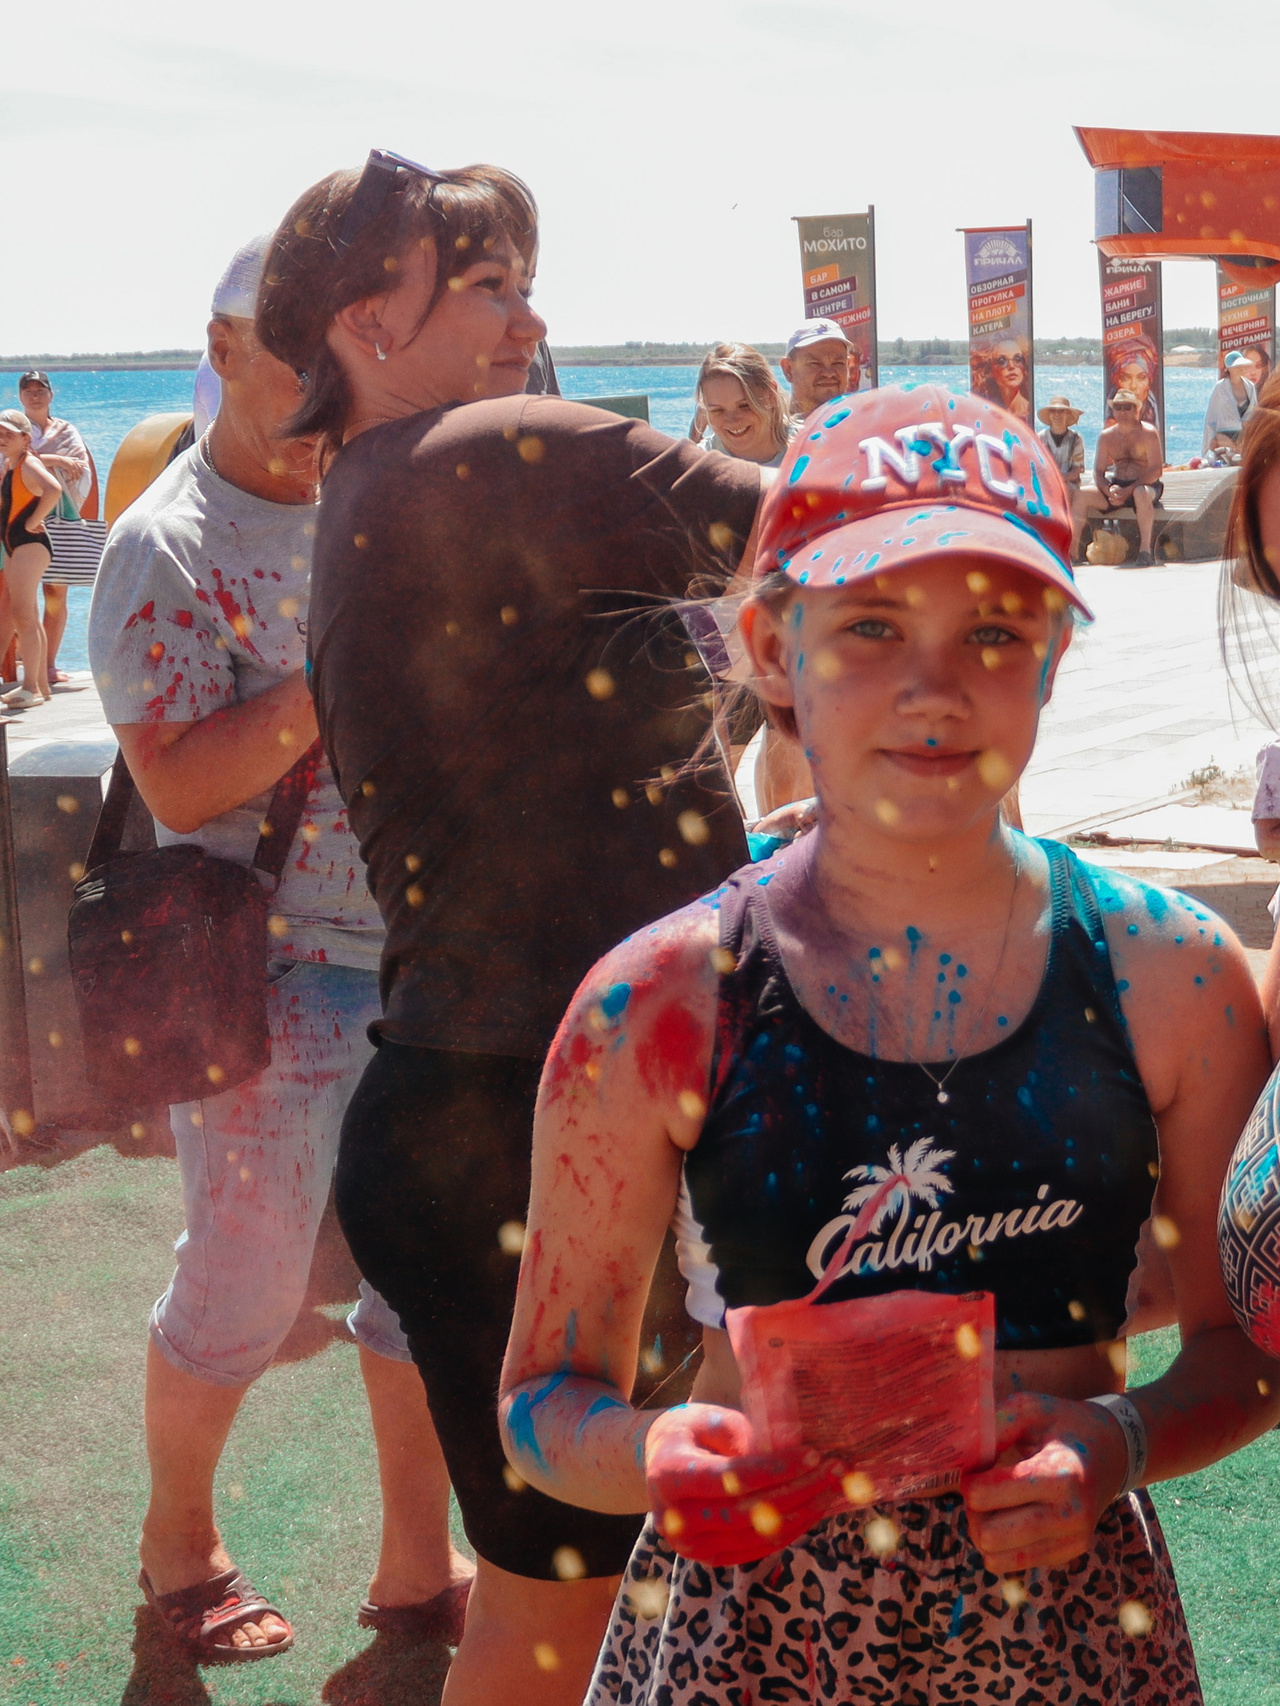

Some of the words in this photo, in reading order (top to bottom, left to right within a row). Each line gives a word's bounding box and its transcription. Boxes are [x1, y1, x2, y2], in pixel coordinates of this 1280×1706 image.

[823, 226, 844, 239] бар
[803, 237, 867, 253] МОХИТО
[973, 256, 1023, 266] ПРИЧАЛ
[1105, 264, 1152, 274] ПРИЧАЛ
[810, 272, 828, 284] БАР
[970, 275, 1014, 294] ОБЗОРНАЯ
[811, 291, 818, 301] В
[819, 282, 851, 299] САМОМ
[1104, 279, 1143, 298] ЖАРКИЕ
[1221, 285, 1238, 297] БАР
[971, 290, 1014, 308] ПРОГУЛКА
[1105, 298, 1130, 312] БАНИ
[1221, 291, 1270, 310] ВОСТОЧНАЯ
[812, 300, 847, 317] ЦЕНТРЕ
[972, 311, 985, 322] НА
[986, 304, 1012, 319] ПЛОТУ
[1106, 316, 1119, 327] НА
[1120, 306, 1153, 322] БЕРЕГУ
[1222, 310, 1249, 324] КУХНЯ
[972, 321, 1003, 336] КАТЕРА
[1106, 327, 1135, 341] ОЗЕРА
[1222, 319, 1266, 336] ВЕЧЕРНЯЯ
[1222, 331, 1272, 350] ПРОГРАММА
[857, 421, 1019, 498] NYC
[806, 1184, 1083, 1281] California
